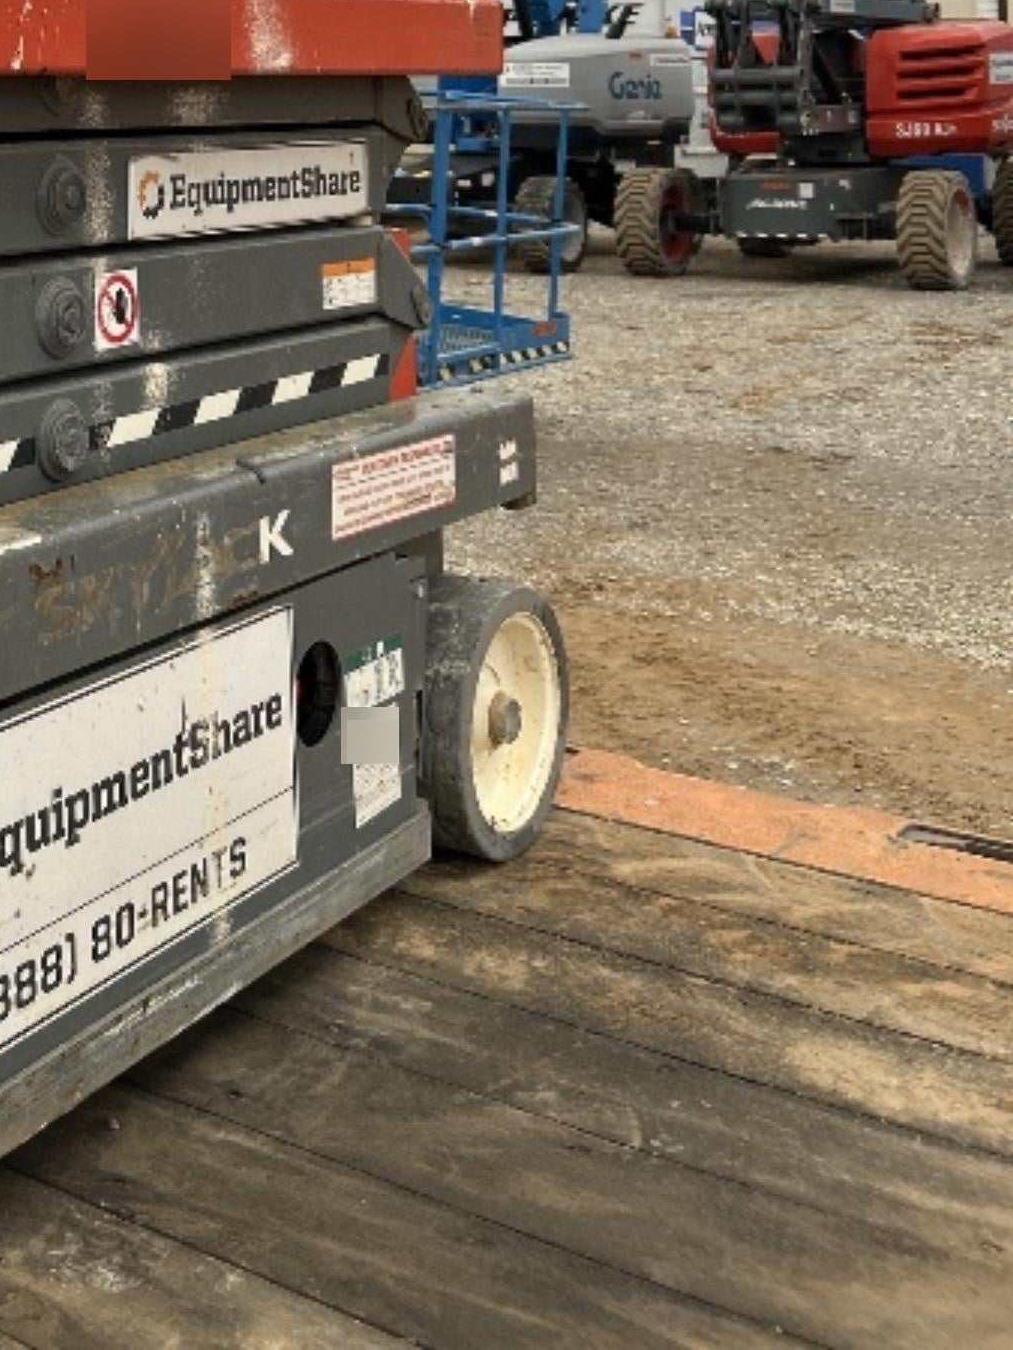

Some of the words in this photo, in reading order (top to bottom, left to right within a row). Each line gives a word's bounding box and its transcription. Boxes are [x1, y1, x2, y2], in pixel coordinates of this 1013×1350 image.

[607, 71, 663, 101] Genie
[169, 164, 361, 216] EquipmentShare
[90, 836, 247, 964] 80-RENTS
